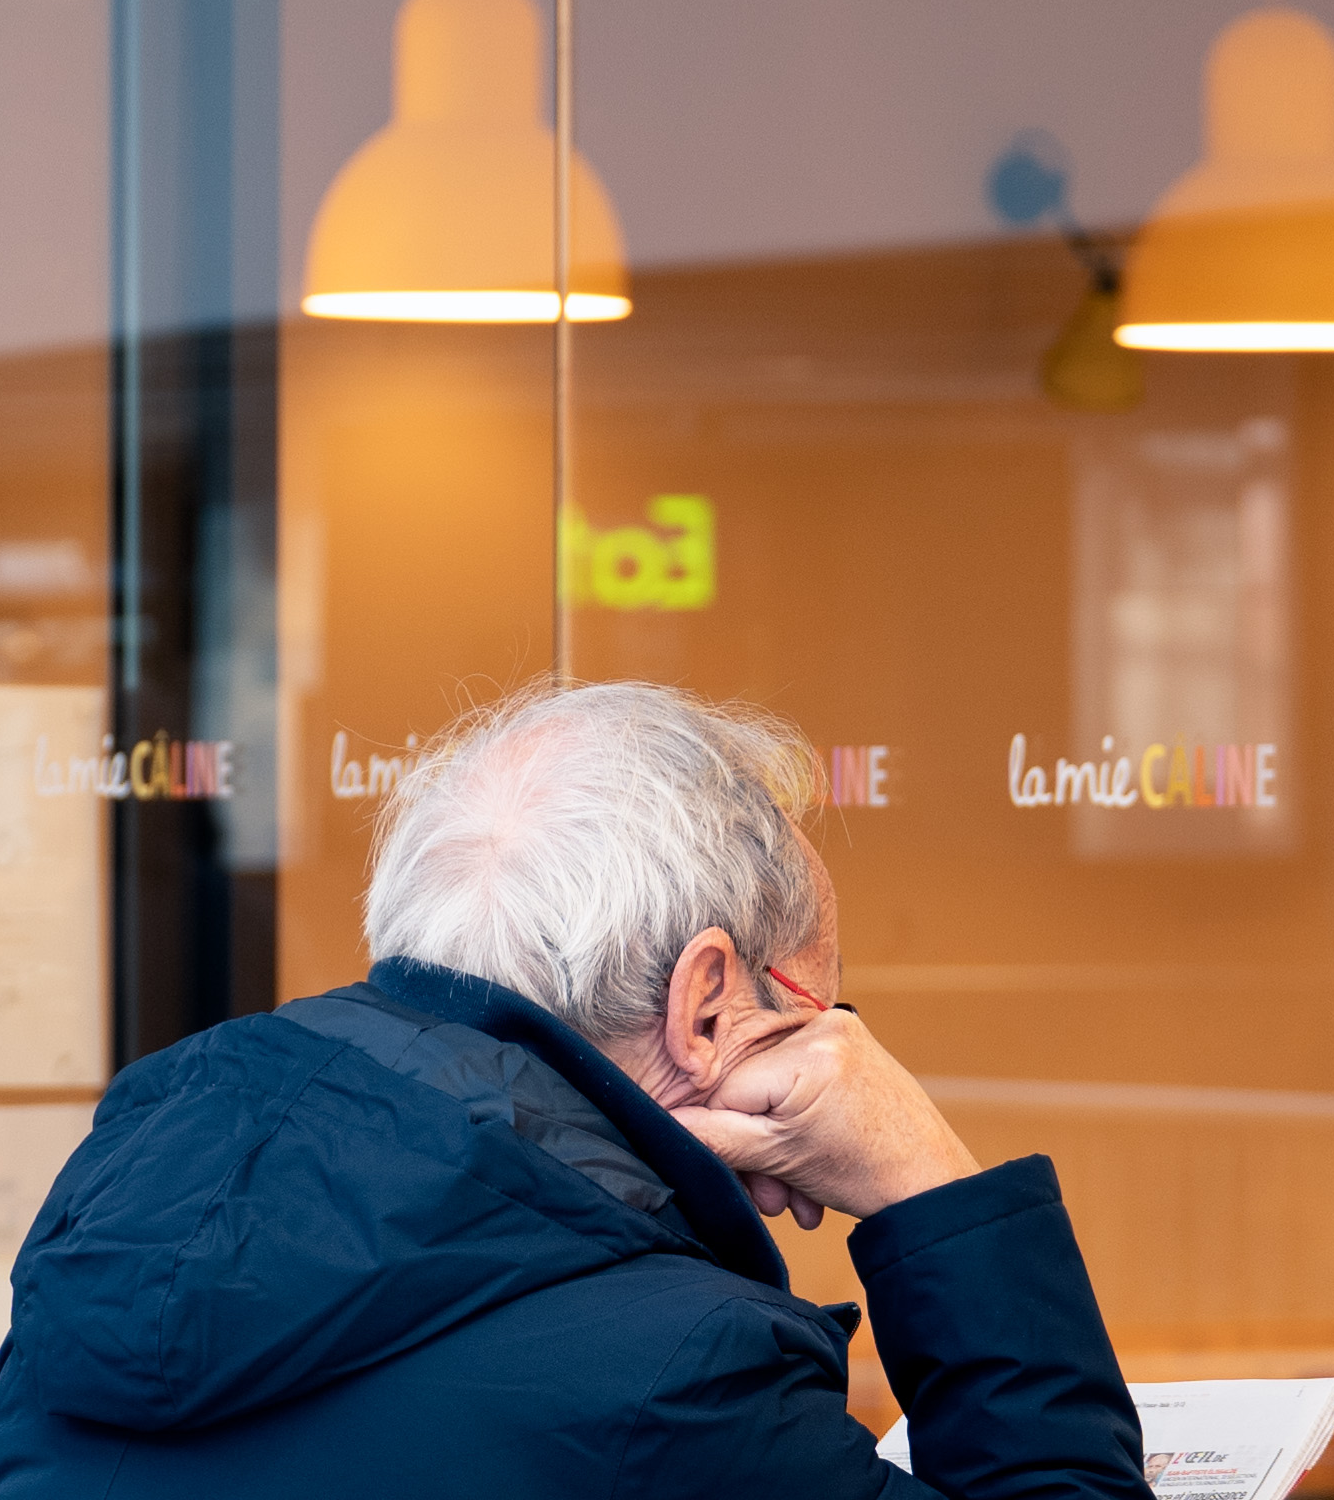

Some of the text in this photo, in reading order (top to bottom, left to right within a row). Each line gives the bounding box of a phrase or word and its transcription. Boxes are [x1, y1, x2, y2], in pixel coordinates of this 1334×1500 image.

[129, 728, 235, 800] CÂLINE
[1008, 731, 1278, 809] la mie CÂLINE
